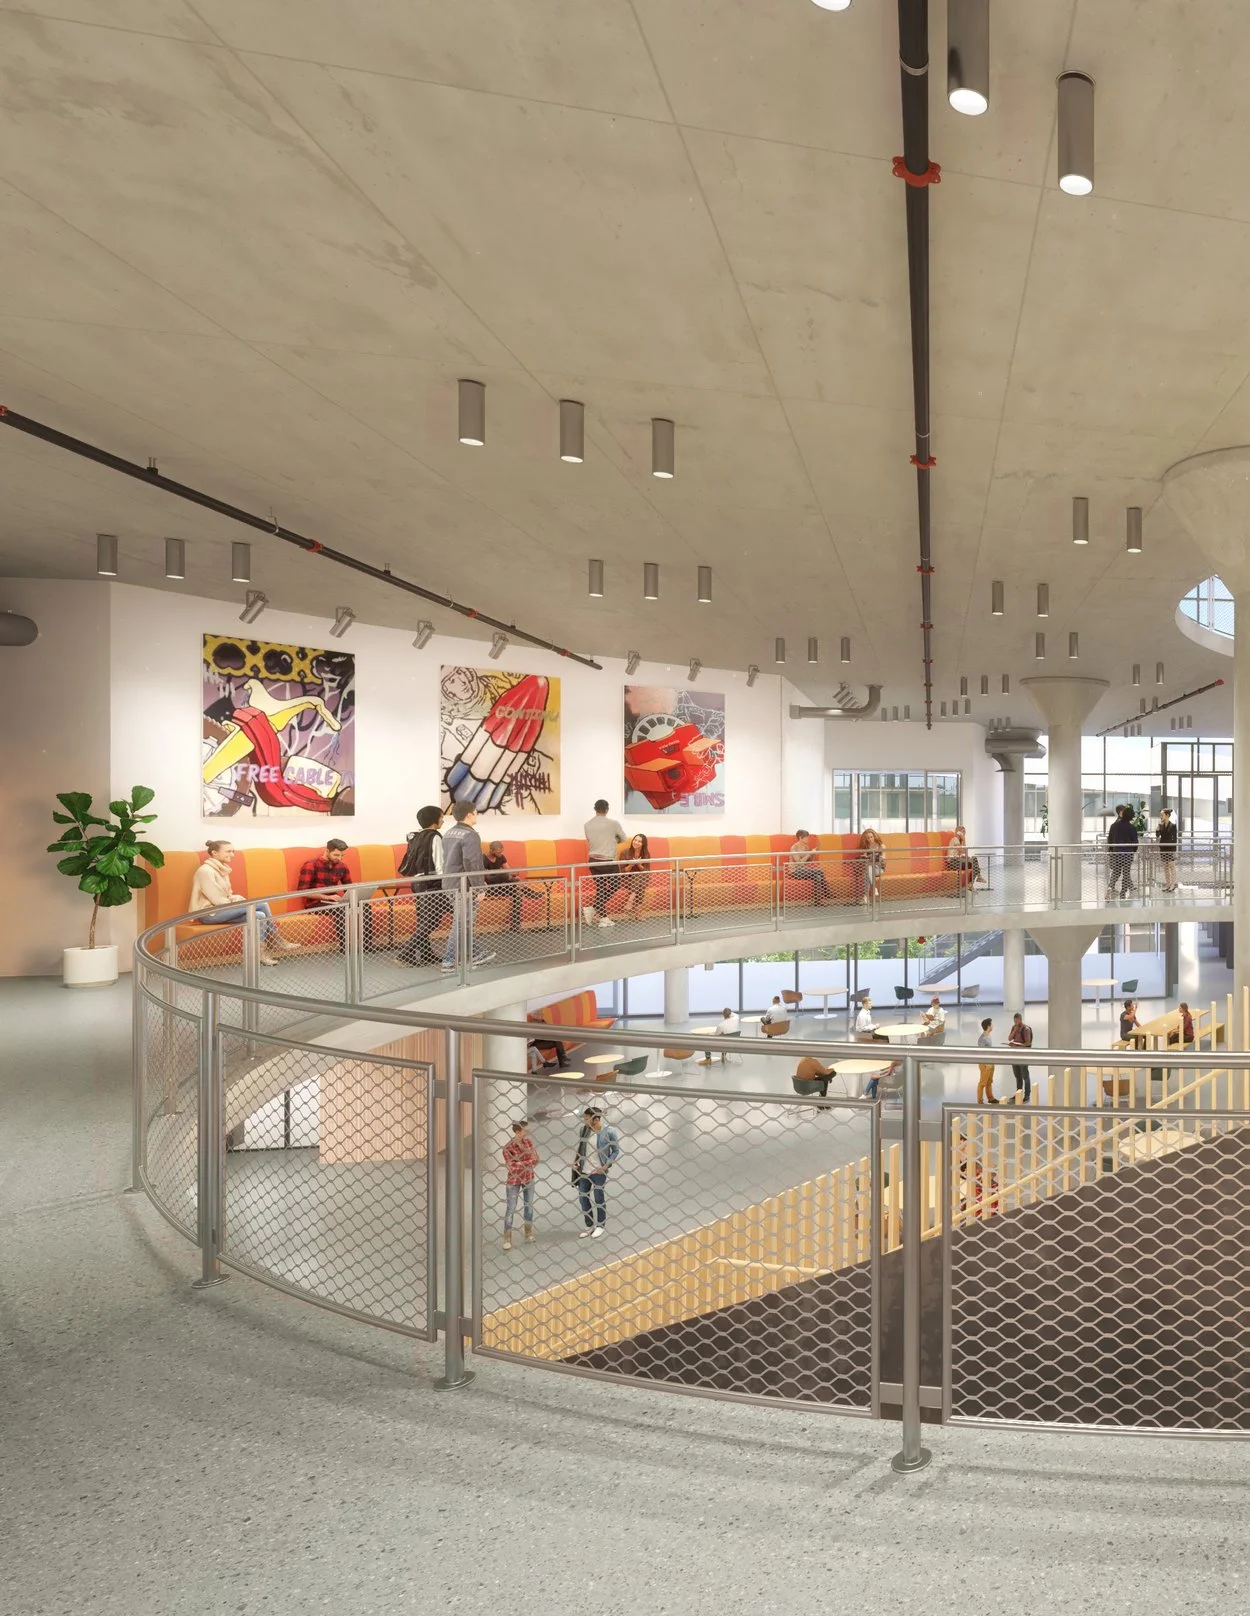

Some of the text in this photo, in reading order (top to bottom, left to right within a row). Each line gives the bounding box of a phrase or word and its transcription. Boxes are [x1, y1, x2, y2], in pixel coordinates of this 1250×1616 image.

[236, 762, 280, 784] FREE
[283, 766, 334, 786] CABLE
[679, 792, 726, 808] SMILE
